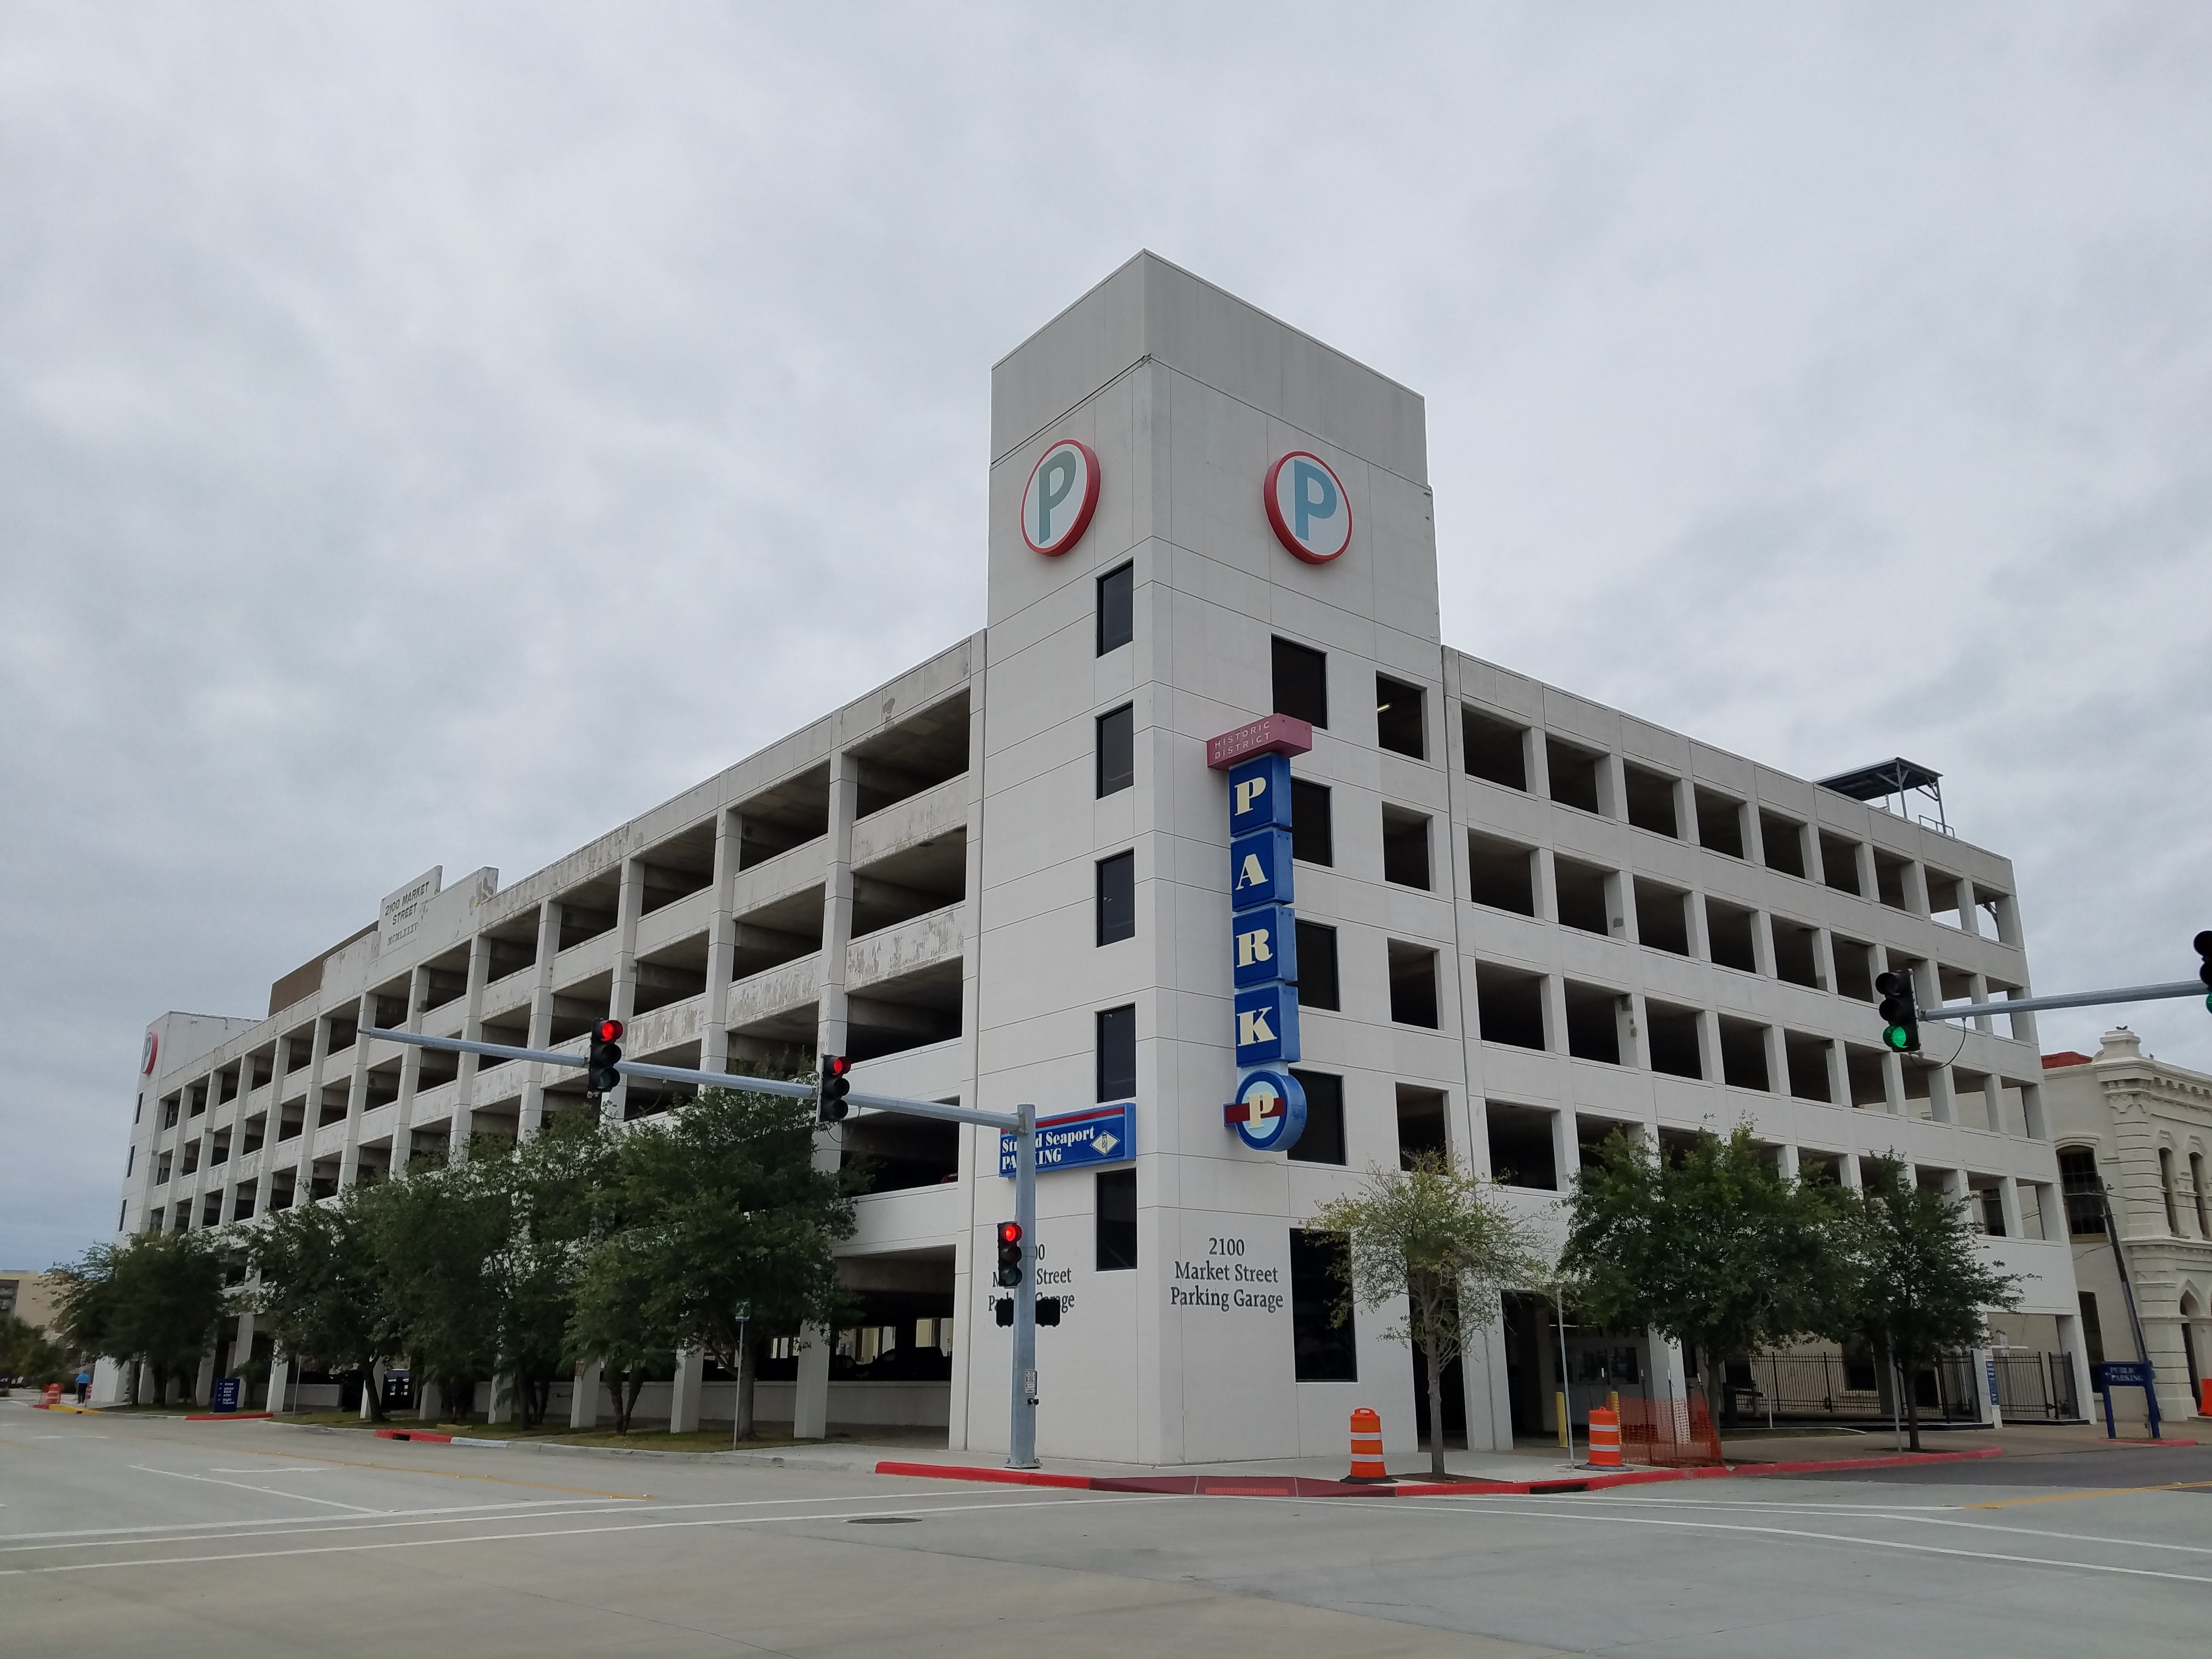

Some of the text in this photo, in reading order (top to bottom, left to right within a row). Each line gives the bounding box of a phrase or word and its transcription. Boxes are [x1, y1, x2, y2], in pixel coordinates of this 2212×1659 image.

[1039, 450, 1076, 545] P
[1294, 459, 1338, 541] P
[1214, 721, 1270, 749] HISTORIC
[1214, 732, 1270, 760] DISTRICT
[385, 881, 430, 916] 2100 MARKET
[1234, 777, 1277, 1047] PARK
[392, 902, 417, 925] STREET
[1247, 1092, 1274, 1129] P
[1002, 1125, 1095, 1154] Strd Seaport
[1002, 1147, 1062, 1170] PAING
[1209, 1237, 1245, 1256] 2100
[1037, 1267, 1072, 1285] Street
[1175, 1260, 1279, 1283] Market Street
[1170, 1285, 1283, 1313] Parking Garage
